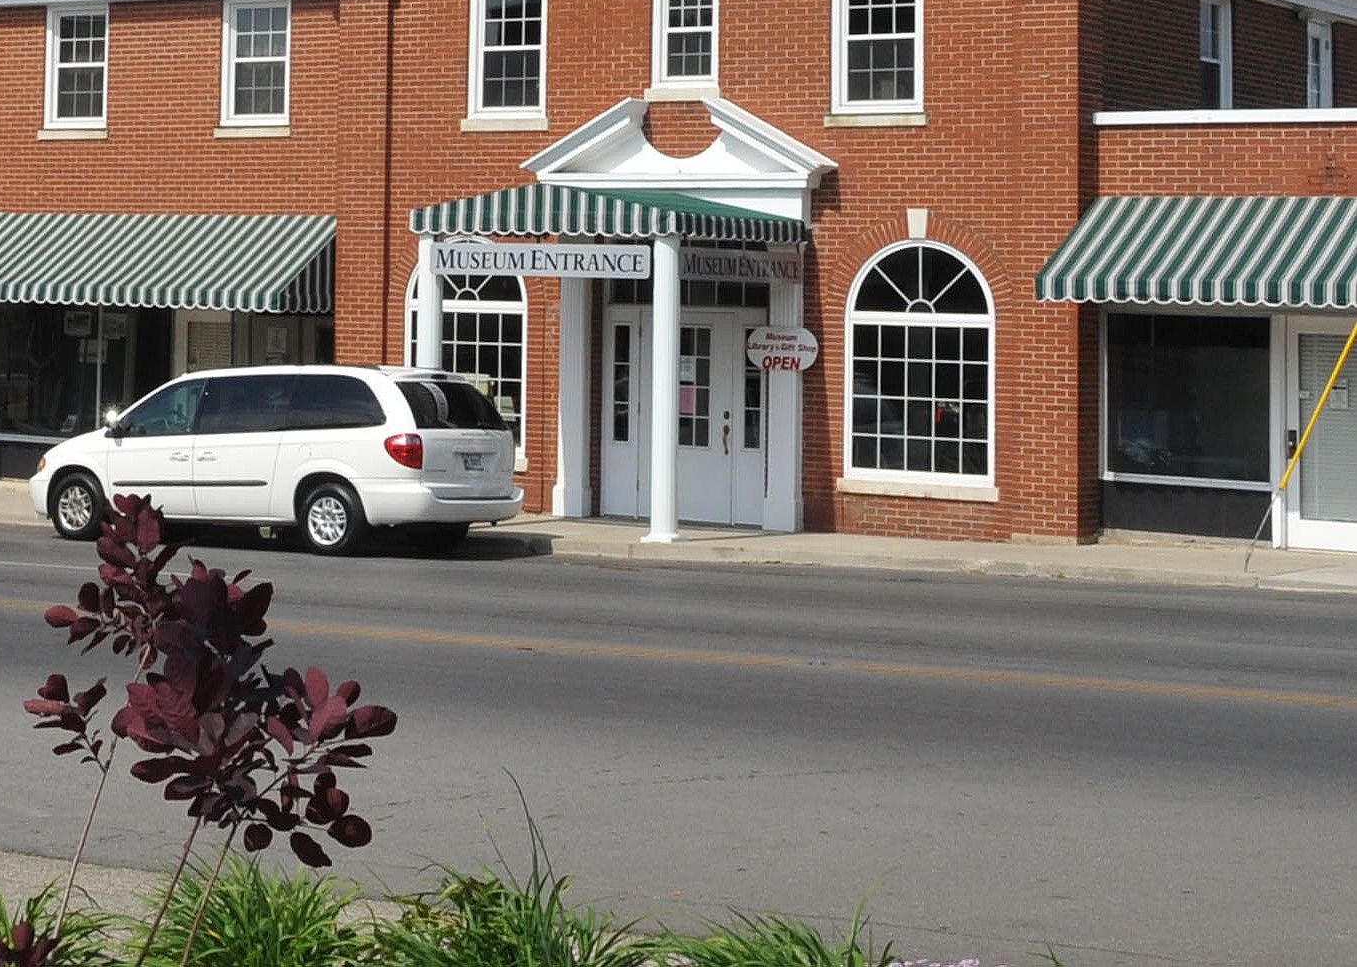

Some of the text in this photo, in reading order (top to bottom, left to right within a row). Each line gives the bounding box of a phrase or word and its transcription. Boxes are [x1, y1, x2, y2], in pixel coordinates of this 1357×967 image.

[435, 248, 644, 273] MUSEUM ENTRANCE
[682, 253, 738, 275] MUSEUM
[763, 355, 801, 371] OPEN
